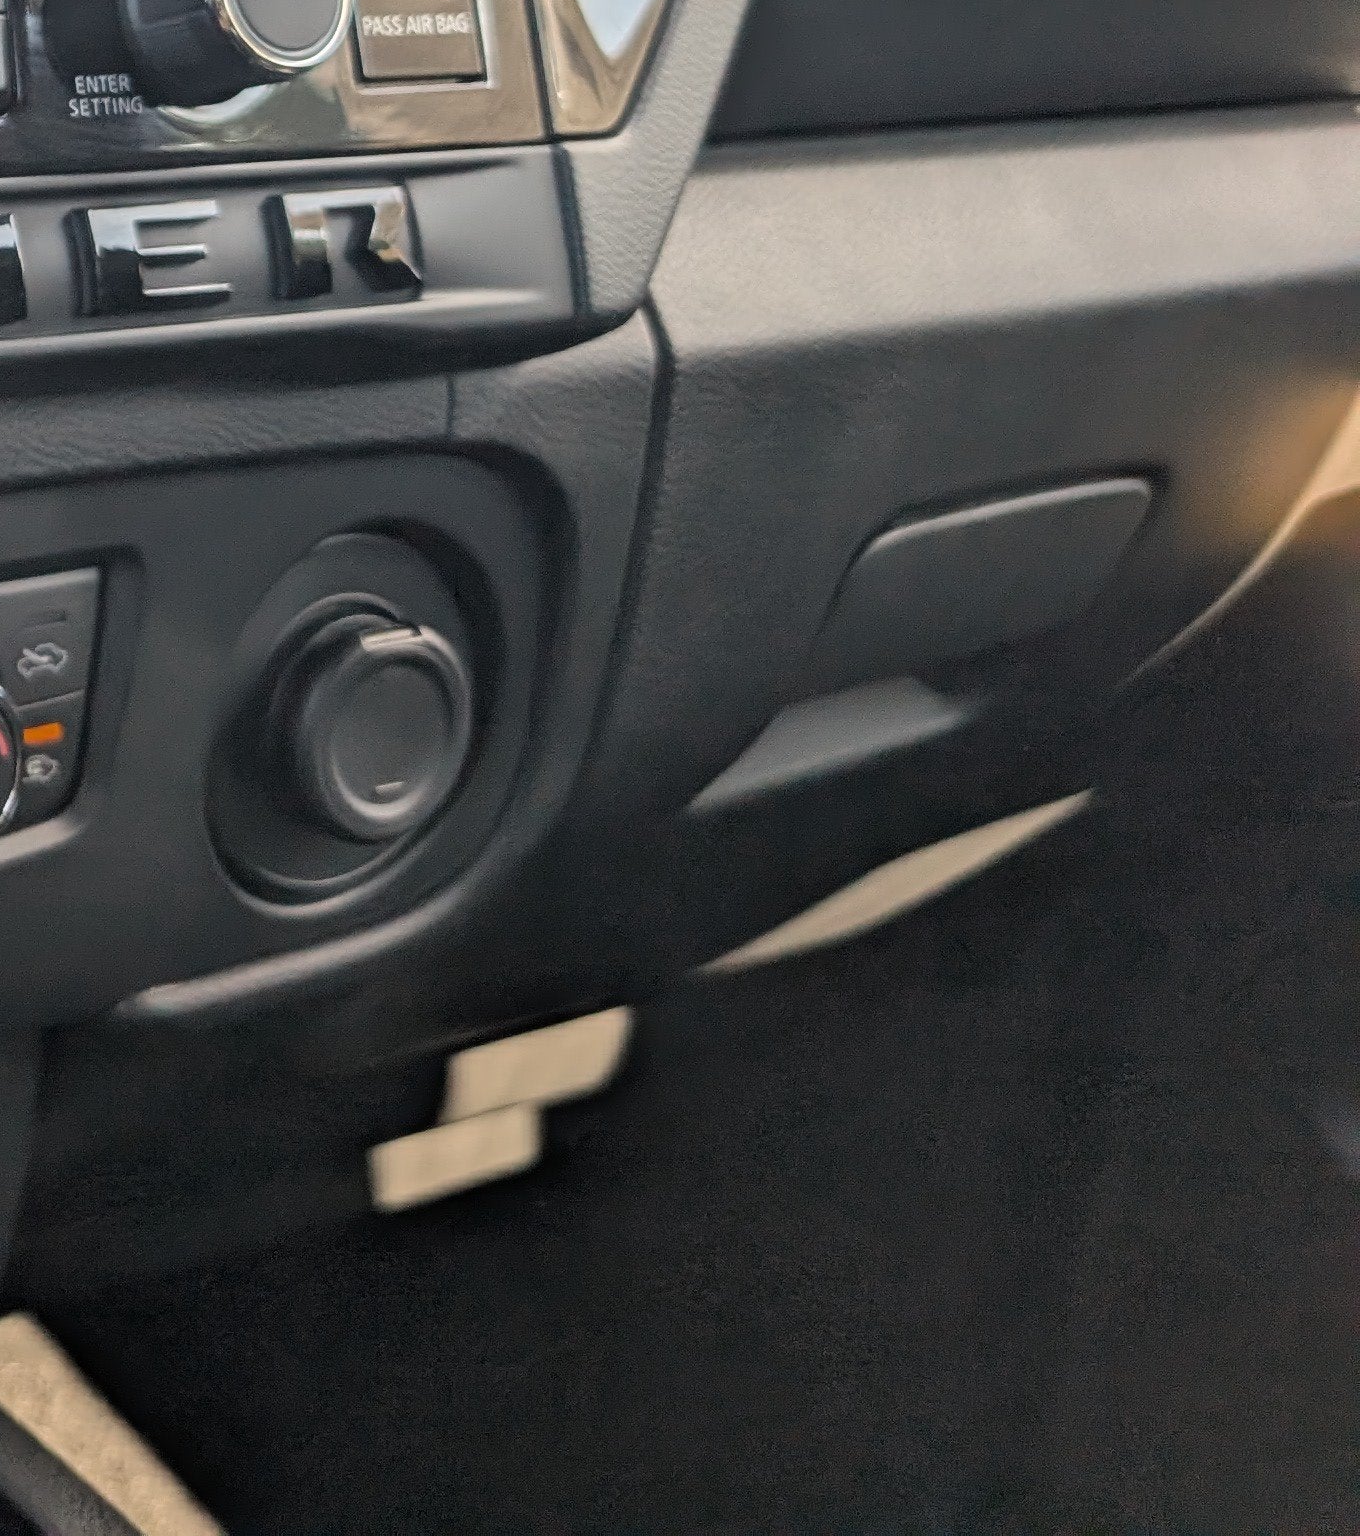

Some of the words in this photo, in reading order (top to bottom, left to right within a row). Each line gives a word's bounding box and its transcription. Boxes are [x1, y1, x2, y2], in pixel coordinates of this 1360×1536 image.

[361, 14, 406, 37] PASS
[406, 13, 436, 35] AIR
[436, 11, 472, 35] BAG
[74, 72, 131, 96] ENTER
[68, 95, 143, 118] SETTING
